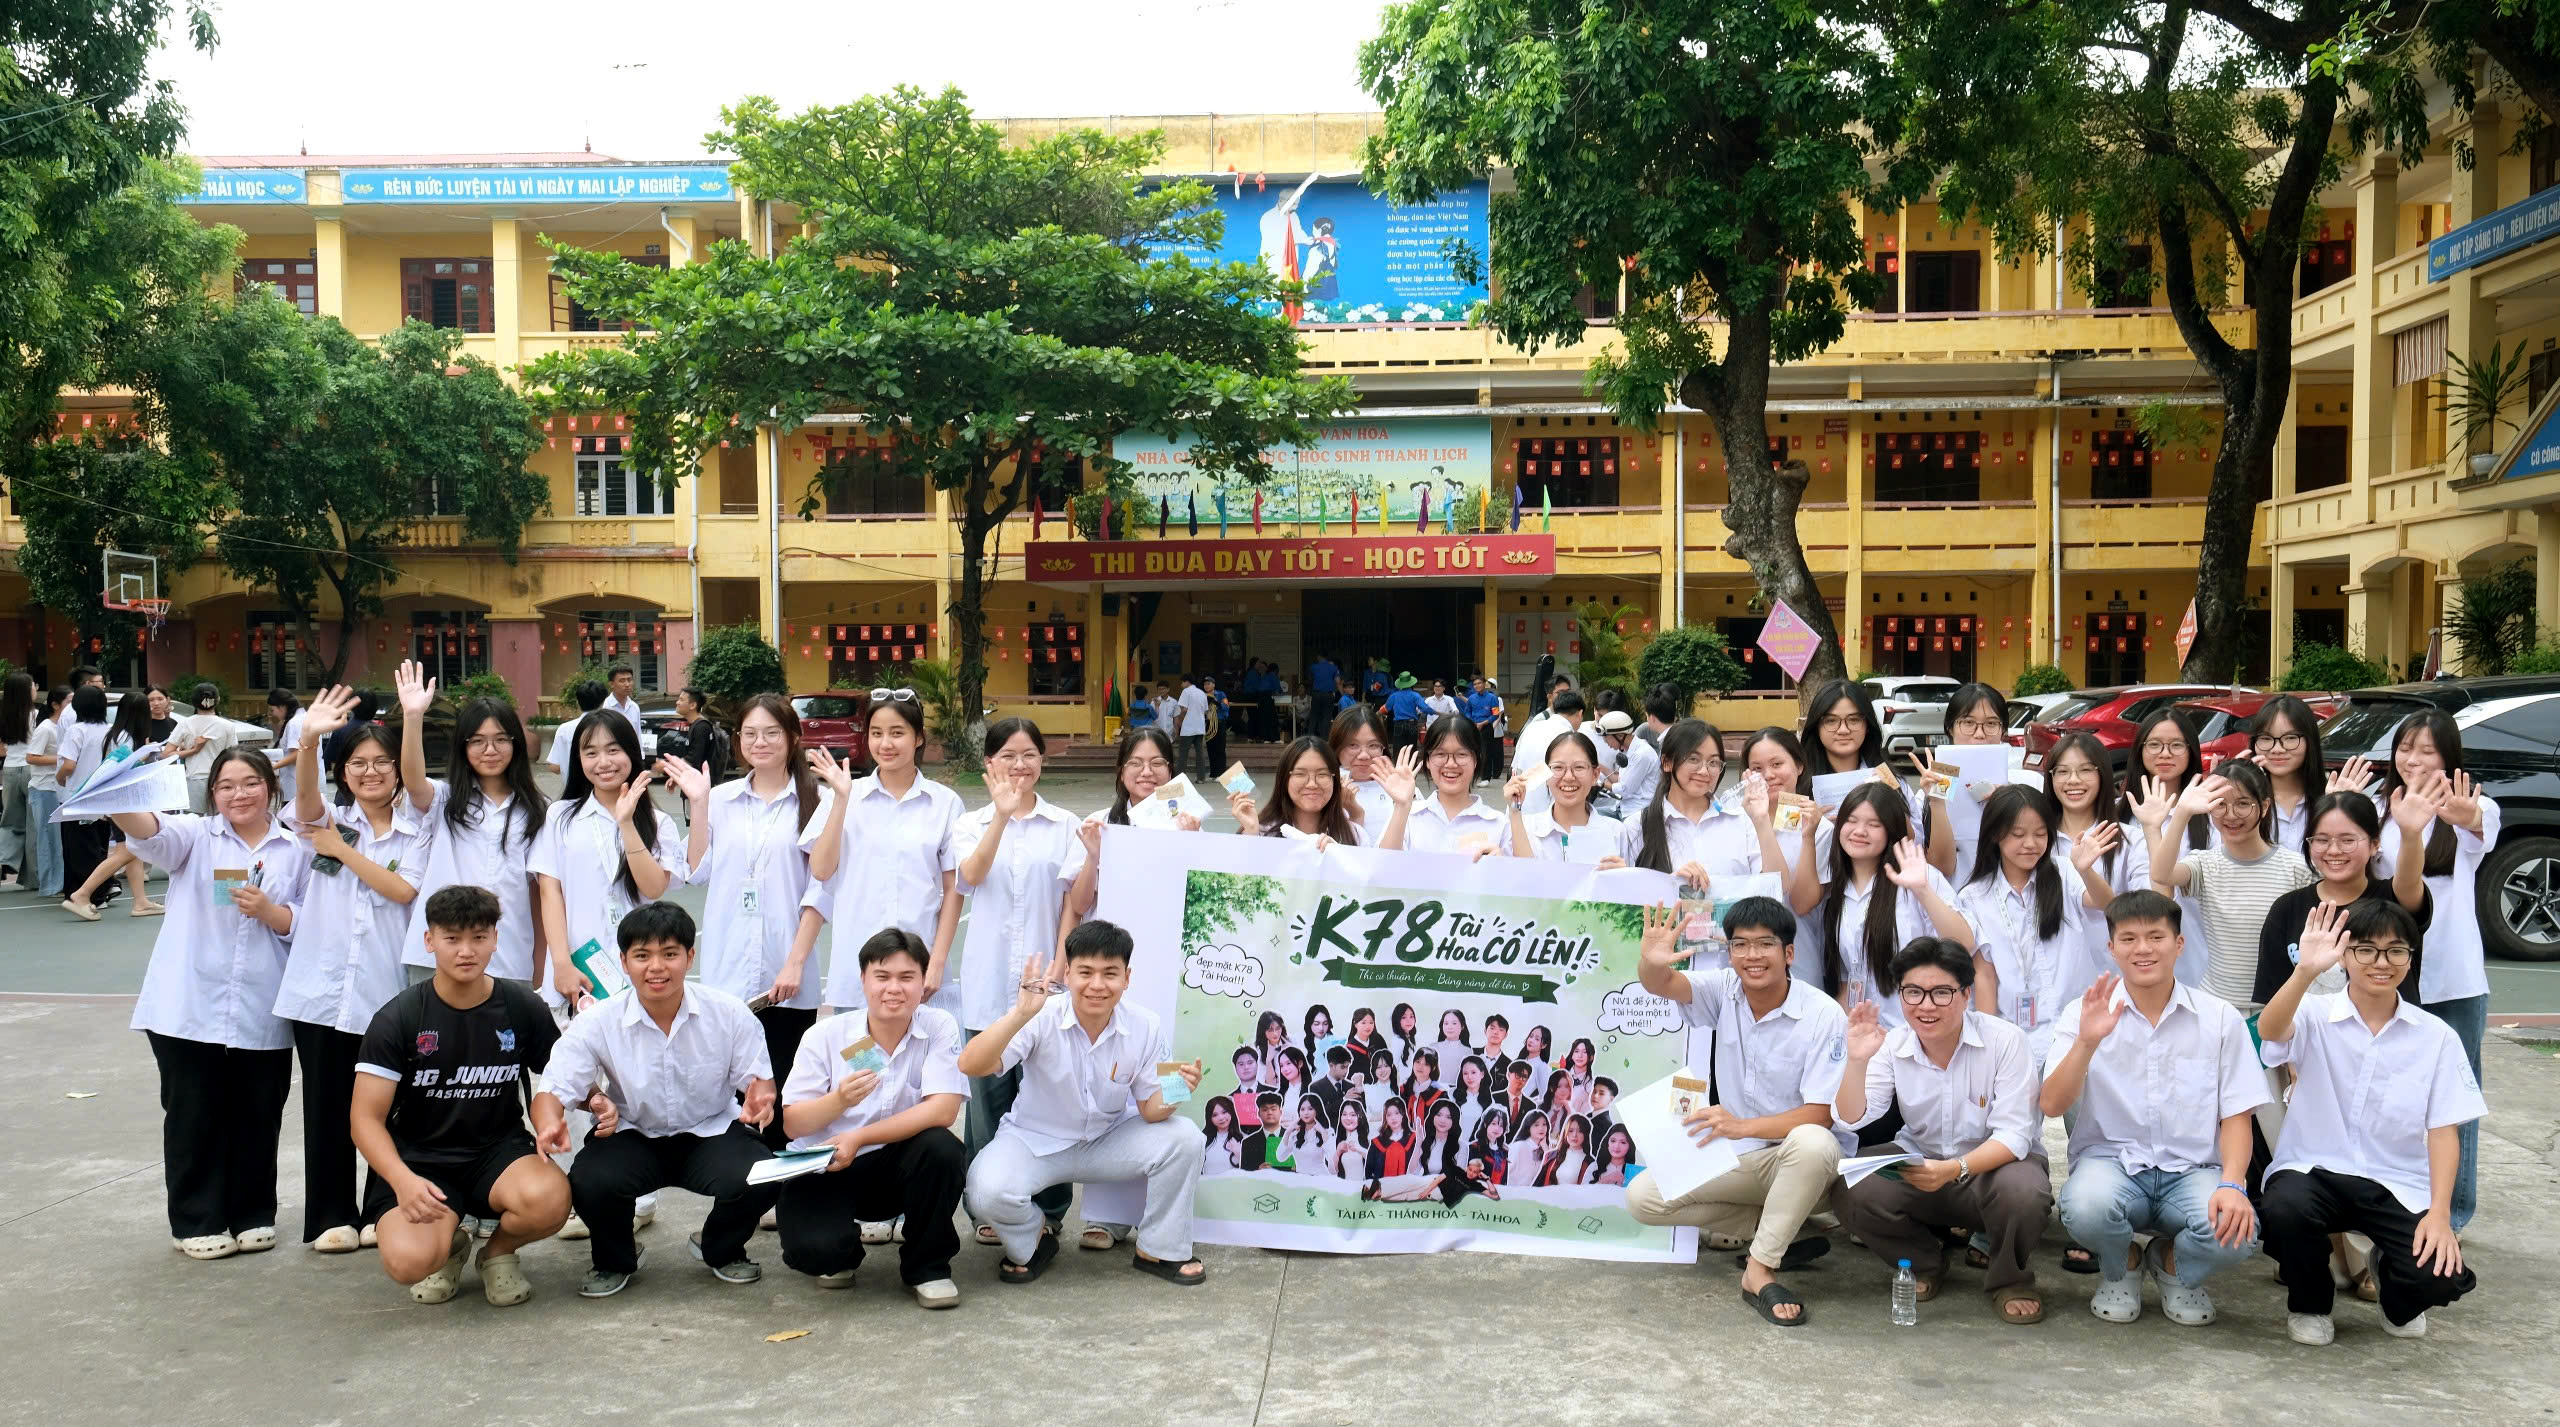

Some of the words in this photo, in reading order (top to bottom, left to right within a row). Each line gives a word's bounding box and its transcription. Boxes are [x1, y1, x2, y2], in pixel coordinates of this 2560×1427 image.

[236, 181, 265, 199] HỌC
[384, 177, 411, 195] RÈN
[416, 177, 443, 195] ĐỨC
[448, 177, 490, 198] LUYỆN
[495, 177, 516, 195] TÀI
[519, 176, 533, 194] VÌ
[537, 176, 573, 194] NGÀY
[579, 179, 605, 194] MAI
[609, 176, 635, 197] LẬP
[639, 175, 690, 196] NGHIỆP
[1319, 424, 1352, 440] VĂN
[1136, 449, 1169, 465] NHÀ
[1299, 449, 1330, 466] HỌC
[1334, 450, 1371, 462] SINH
[1375, 449, 1428, 462] THANH
[1433, 448, 1468, 463] LỊCH
[1090, 552, 1135, 573] THI
[1145, 551, 1206, 573] ĐUA
[1214, 550, 1273, 576] DẠY
[1282, 541, 1334, 570] TỐT
[1364, 547, 1425, 573] HỌC
[1434, 537, 1489, 568] TỐT
[1306, 895, 1444, 963] K78
[1449, 912, 1485, 938] Tài
[1435, 937, 1481, 961] Hoa
[1482, 920, 1535, 965] CỐ
[1524, 928, 1592, 970] LÊN!
[1196, 957, 1213, 969] đẹp
[1215, 960, 1233, 971] mặt
[1234, 962, 1253, 974] K78
[1358, 968, 1374, 980] Thi
[1200, 969, 1215, 980] Tài
[1216, 972, 1244, 985] Hoa!!!
[1612, 997, 1630, 1006] NV1
[1652, 997, 1669, 1006] K78
[1612, 1007, 1625, 1016] Tài
[1626, 1008, 1644, 1016] Hoa
[1645, 1008, 1662, 1018] một
[1627, 1019, 1652, 1028] nhé!!!
[446, 1064, 520, 1085] JUNIOR
[425, 1087, 502, 1099] BASKETBALL
[1336, 1208, 1356, 1219] TÀI
[1358, 1209, 1375, 1219] BA
[1432, 1209, 1459, 1219] HOA
[1470, 1209, 1490, 1221] TÀI
[1493, 1214, 1521, 1225] HOA
